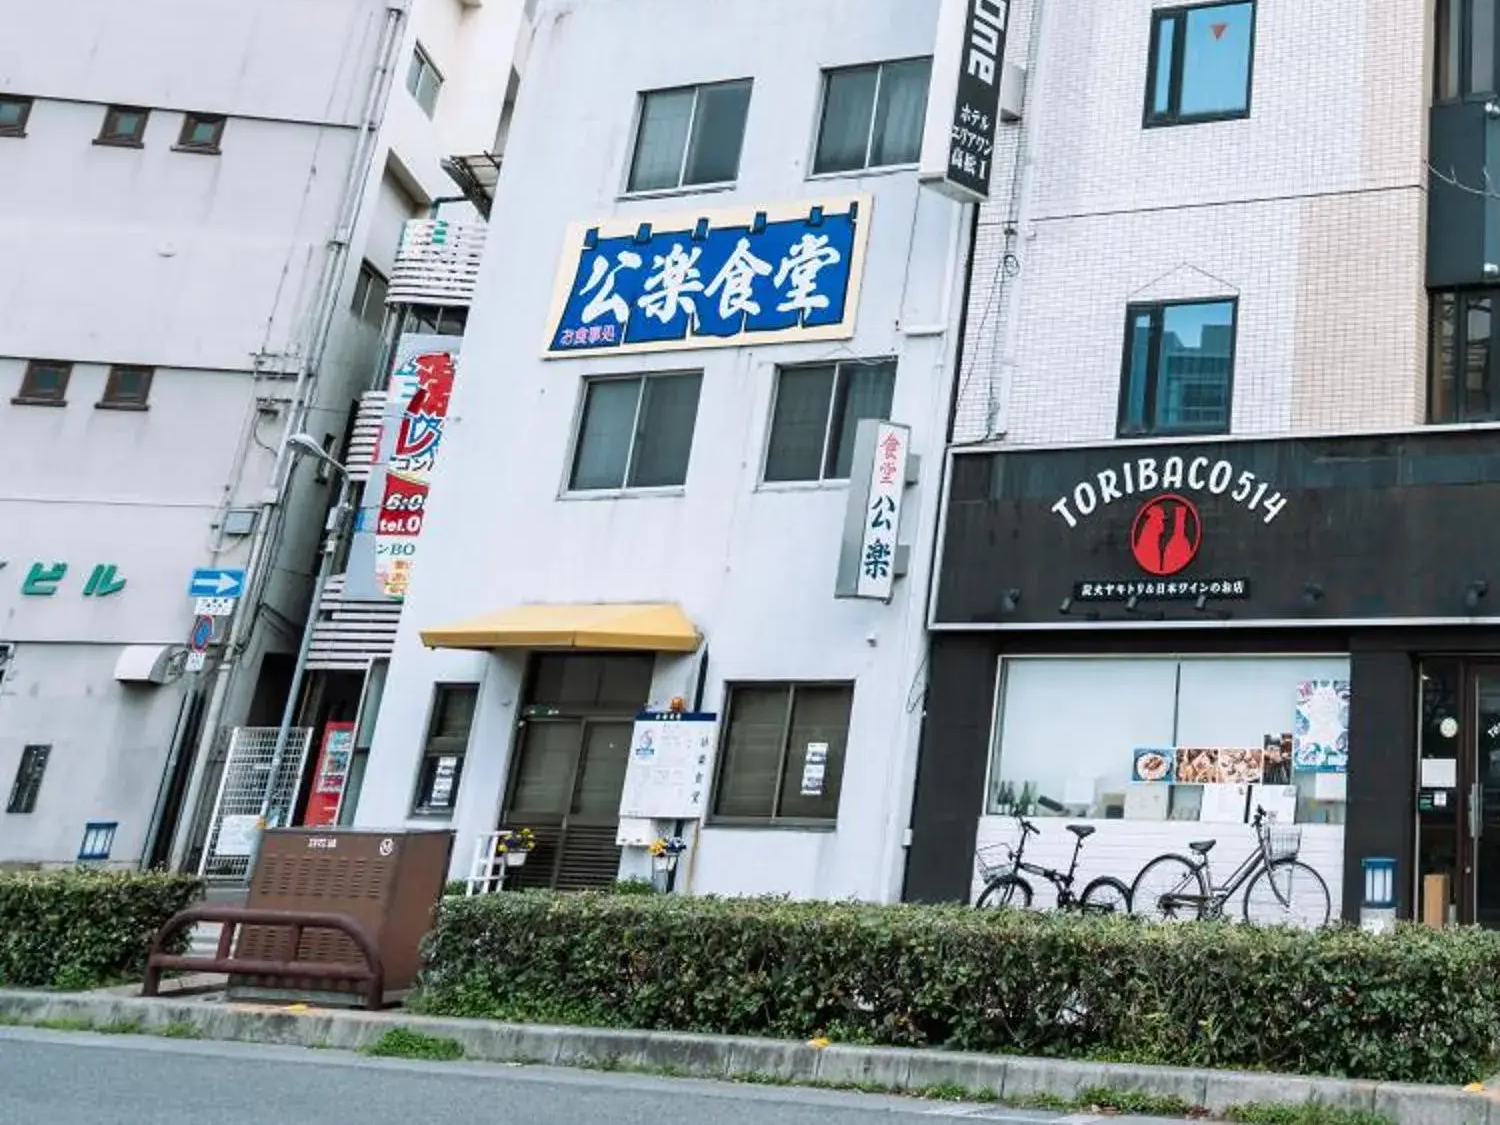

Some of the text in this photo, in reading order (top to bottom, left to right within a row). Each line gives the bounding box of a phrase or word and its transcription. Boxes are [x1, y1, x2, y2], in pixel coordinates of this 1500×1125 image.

[578, 233, 840, 324] 公楽食堂
[1051, 456, 1287, 528] TORIBACO514
[0, 558, 128, 596] ビル
